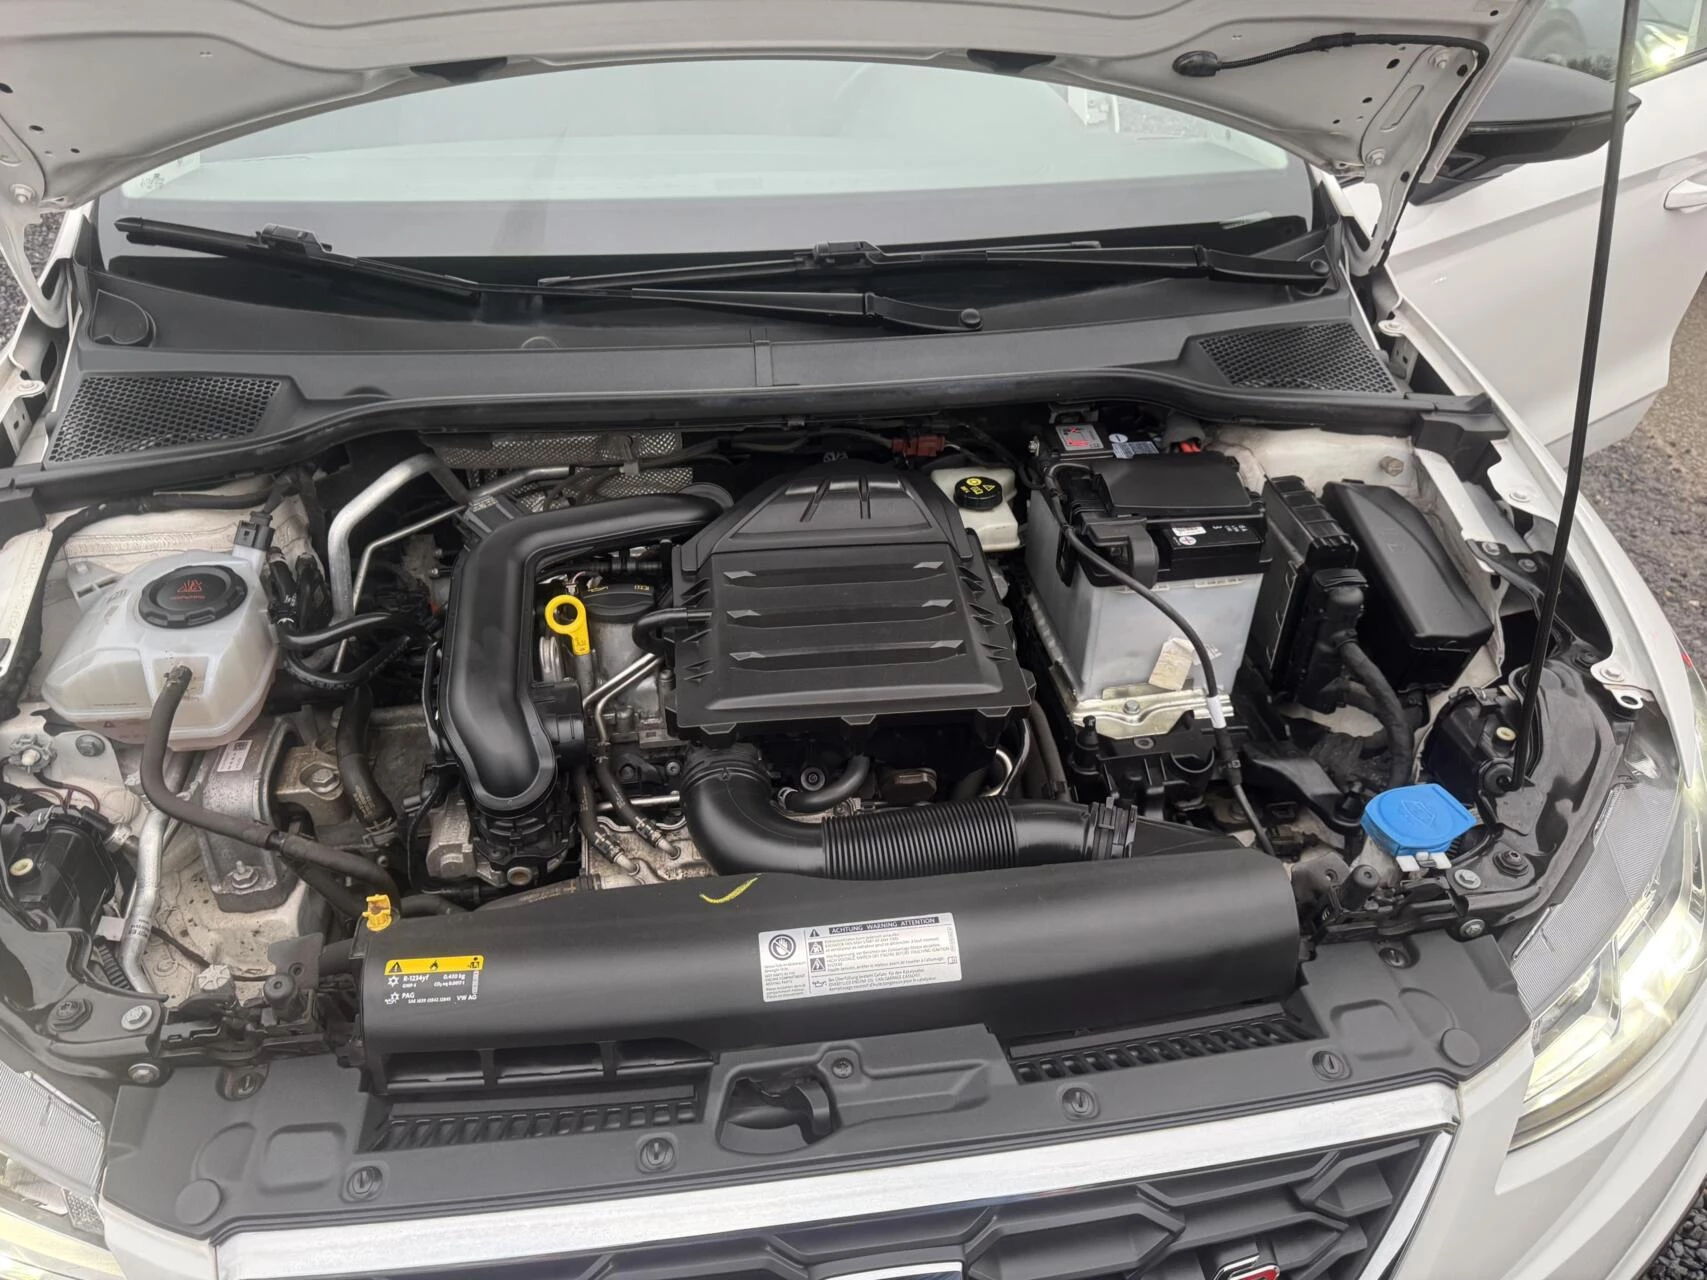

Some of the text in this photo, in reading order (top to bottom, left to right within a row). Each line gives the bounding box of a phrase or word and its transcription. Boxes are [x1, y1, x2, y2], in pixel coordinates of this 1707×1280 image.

[831, 917, 936, 933] ACHTUNG WARNING ATTENTION
